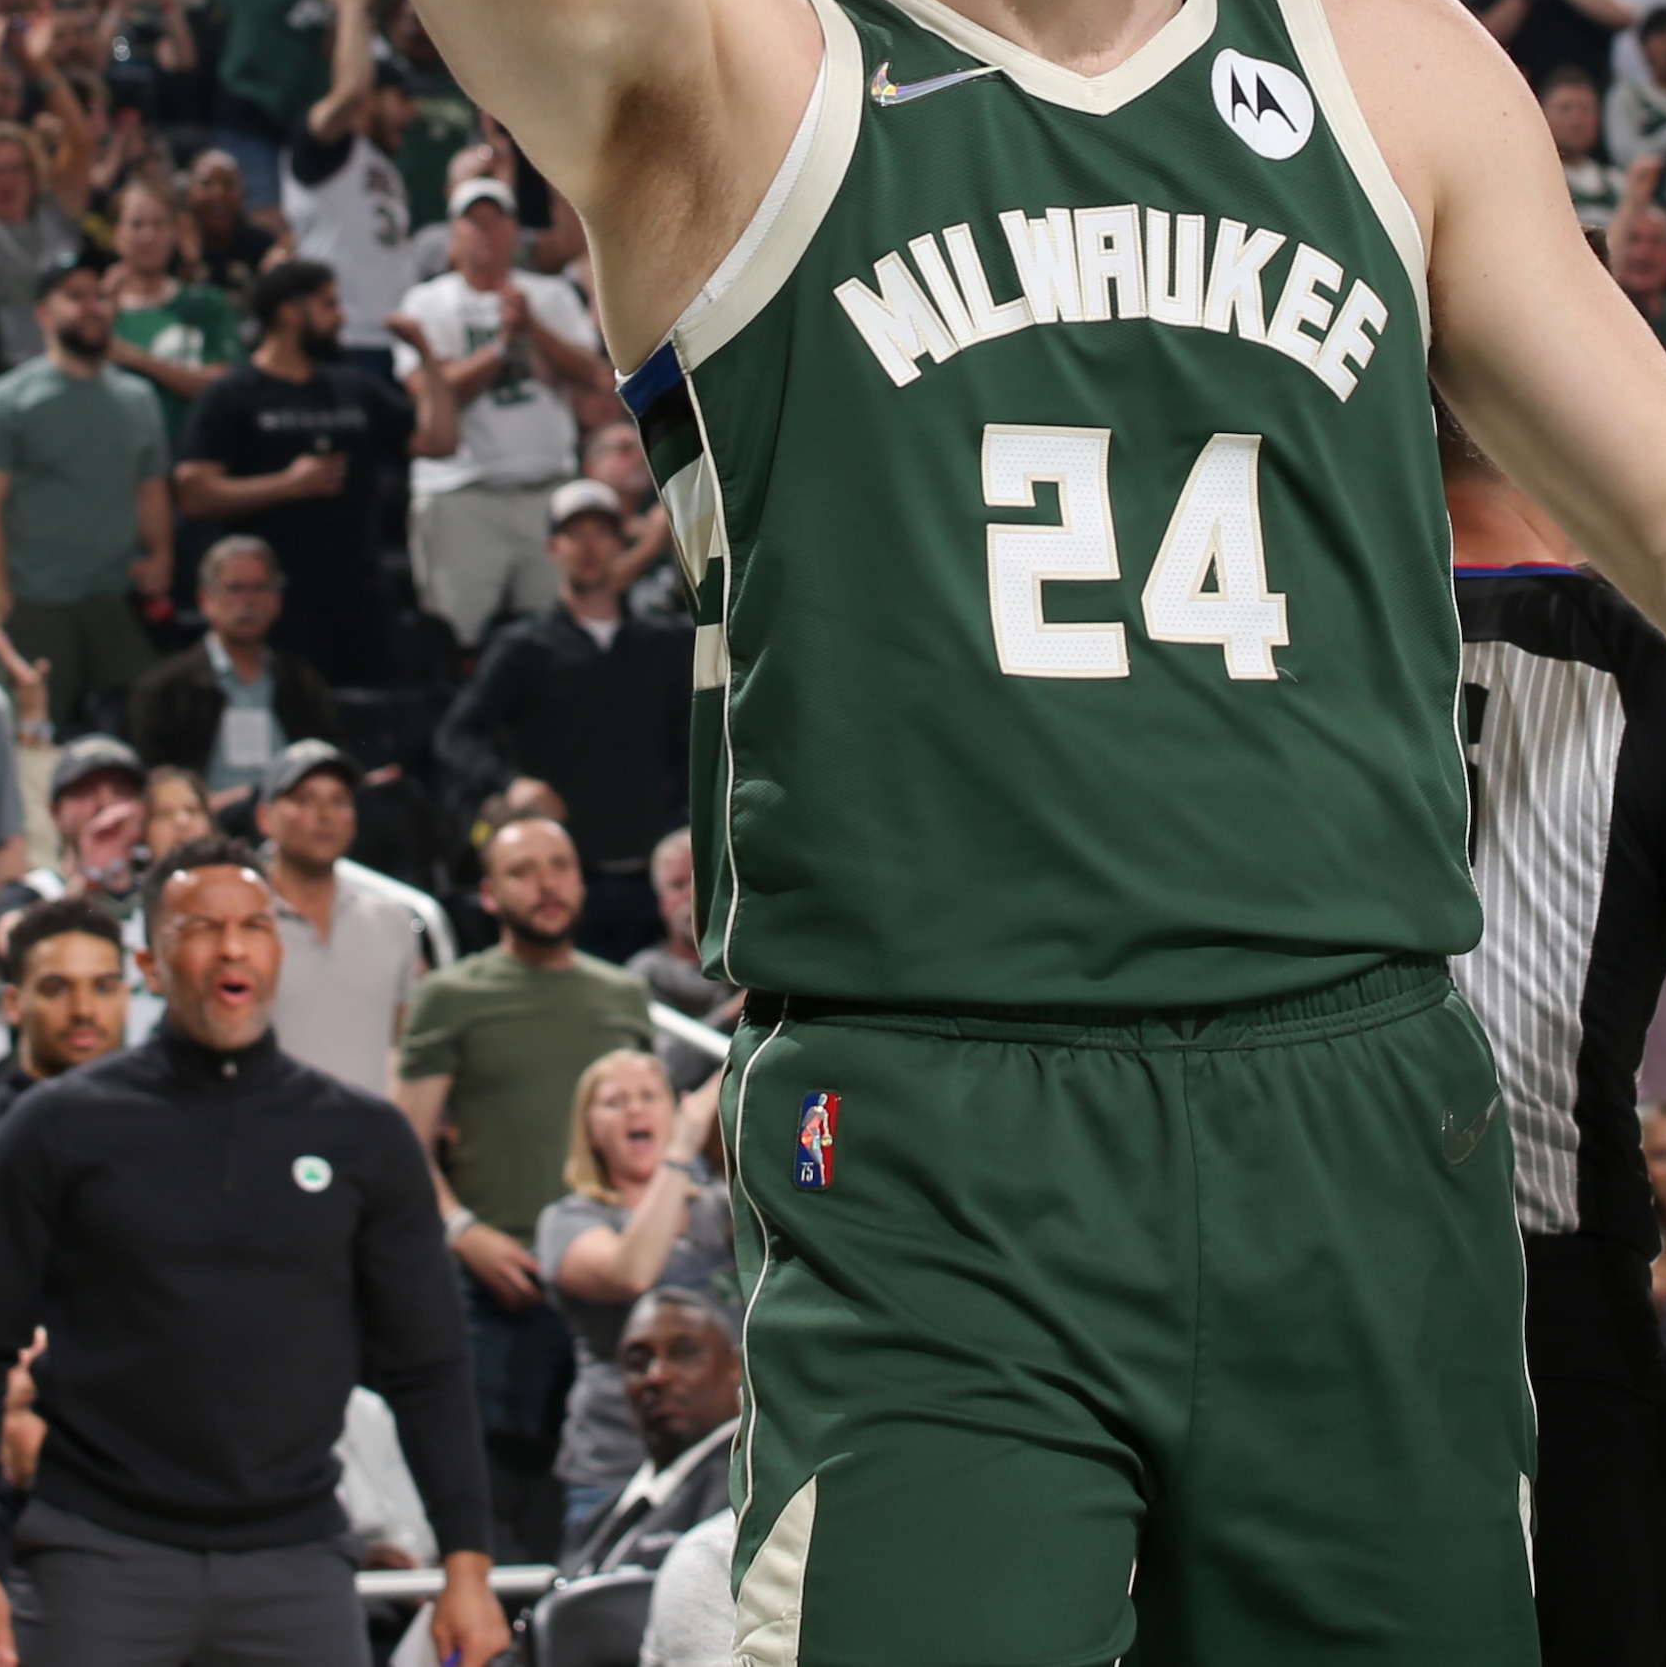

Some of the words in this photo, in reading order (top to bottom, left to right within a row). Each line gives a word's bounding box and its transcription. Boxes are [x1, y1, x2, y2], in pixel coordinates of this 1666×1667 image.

[833, 203, 1389, 403] MILWAUKEE
[981, 422, 1290, 680] 24
[800, 1161, 815, 1182] 75
